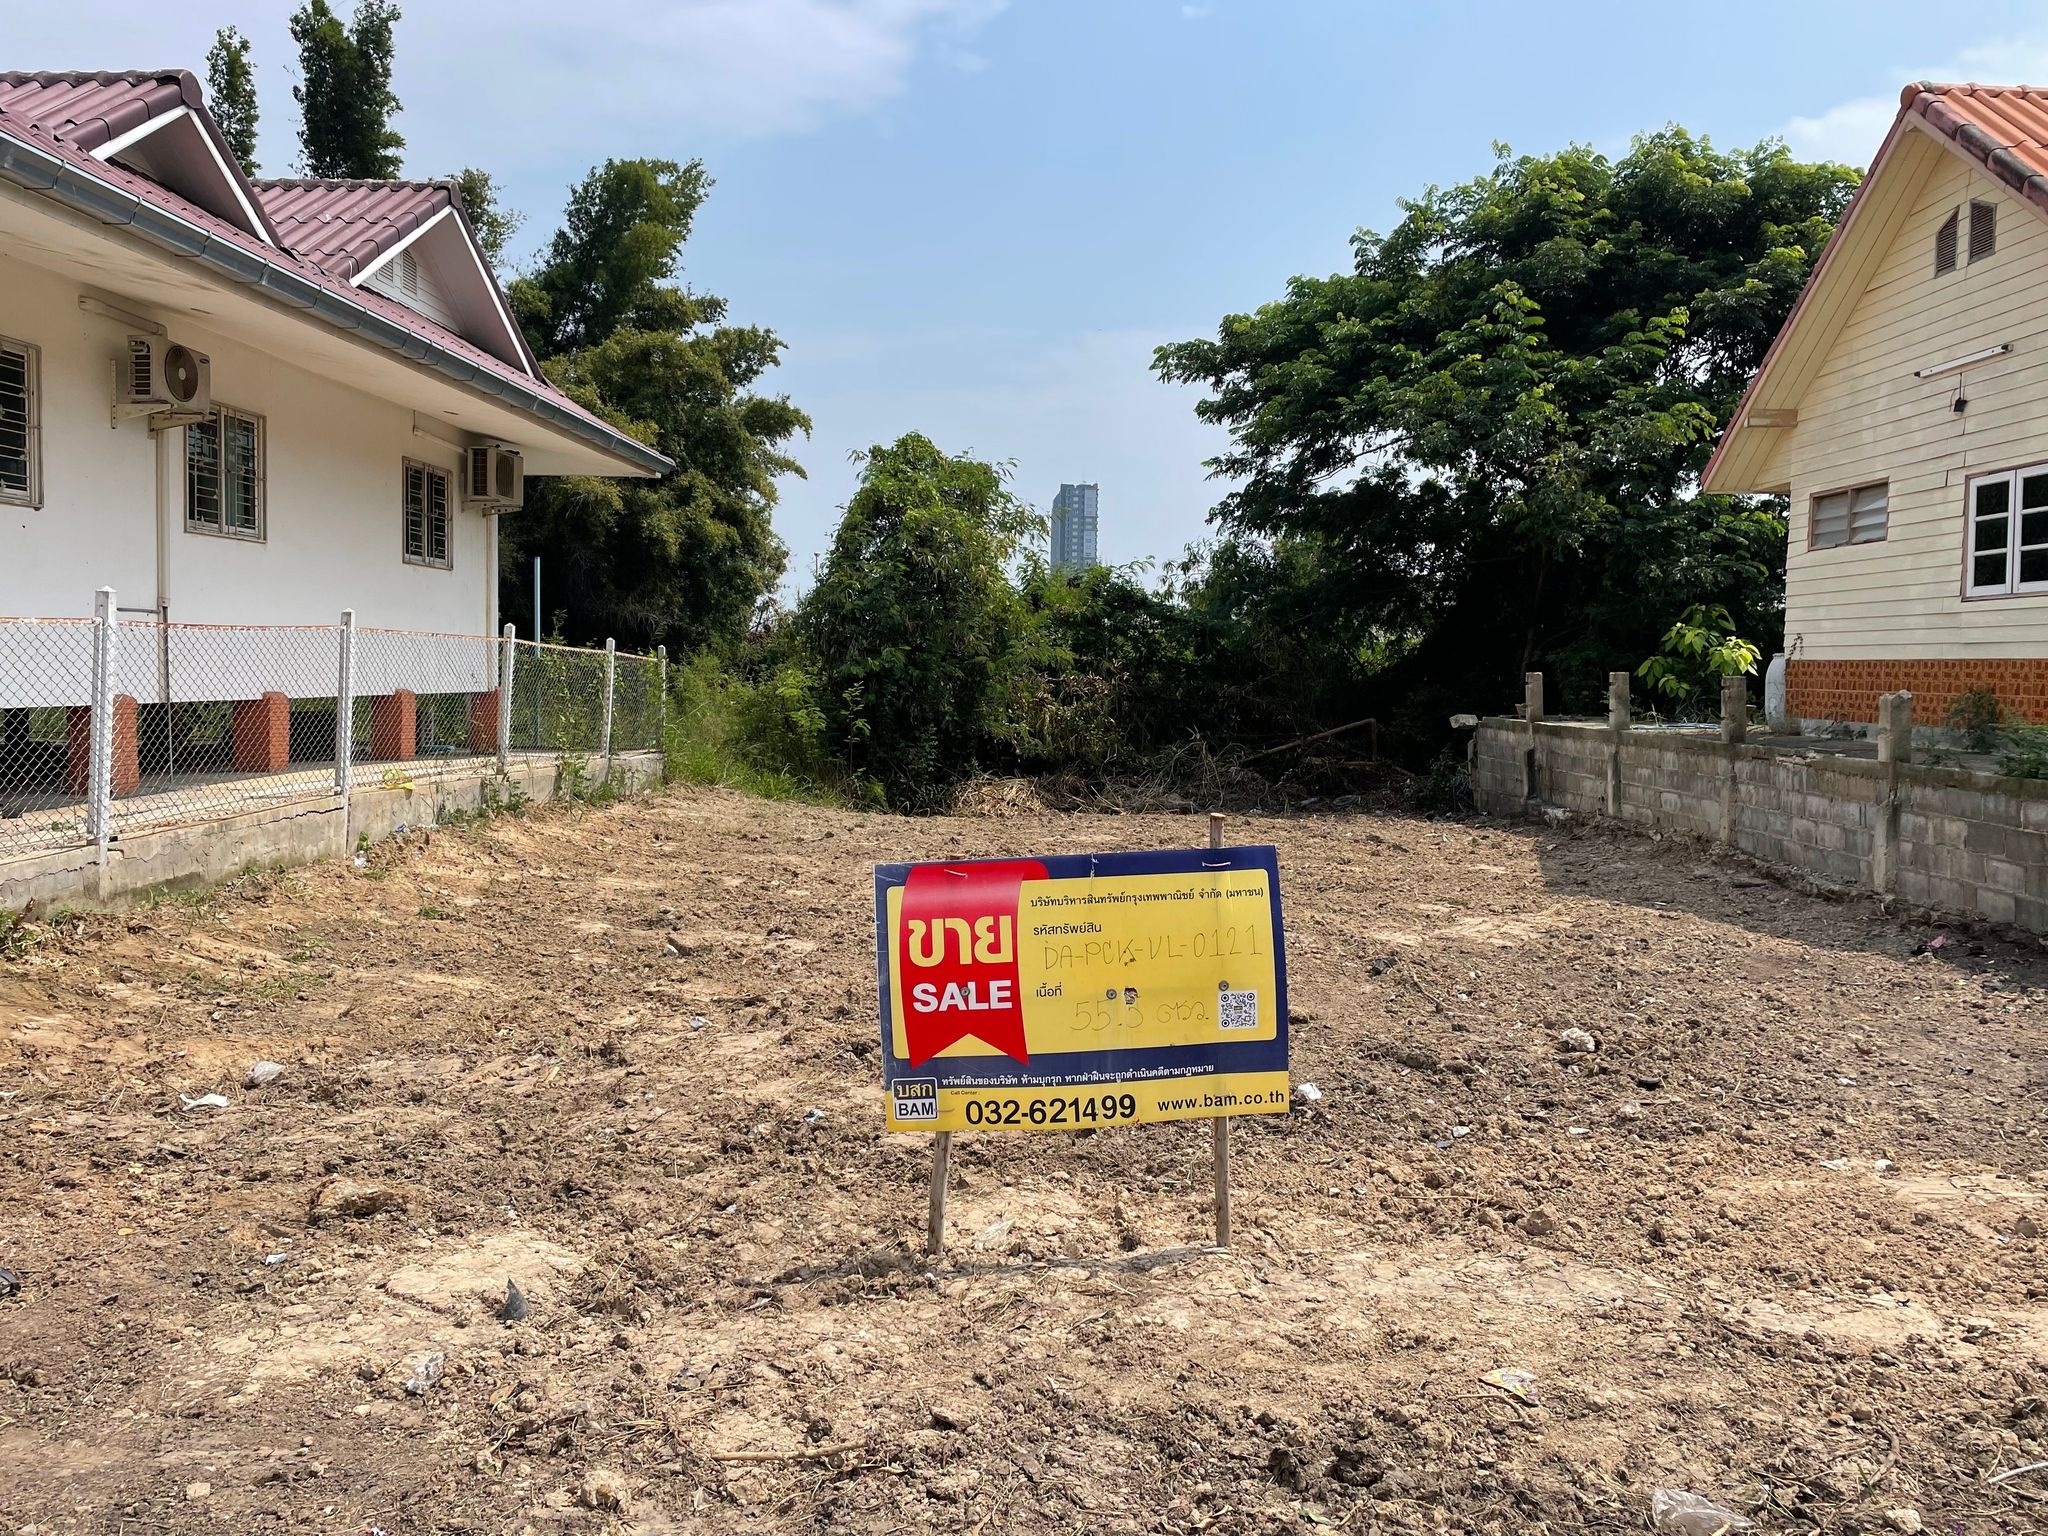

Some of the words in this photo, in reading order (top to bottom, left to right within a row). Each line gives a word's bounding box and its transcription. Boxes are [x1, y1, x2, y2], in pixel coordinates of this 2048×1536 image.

[1030, 888, 1195, 907] บริษัทบริหารสินทรัพย์กรุงเทพพาณิชย์
[1198, 889, 1222, 900] จำกัด
[1225, 887, 1264, 899] (มหาชน)
[1033, 921, 1102, 936] รหัสทรัพย์สิน
[908, 915, 1014, 968] ขาย
[1044, 924, 1263, 970] DA-PCK-VL-0121
[912, 979, 1013, 1013] SALE
[1035, 982, 1062, 998] เนื้อที่
[896, 1083, 933, 1098] บสก
[941, 1075, 1018, 1086] ทรัพย์สินของบริษัท
[1021, 1074, 1062, 1088] ห้ามบุกรุก
[899, 1101, 934, 1116] BAM
[965, 1094, 1136, 1125] 032-621499
[1157, 1090, 1285, 1112] www.bam.co.th
